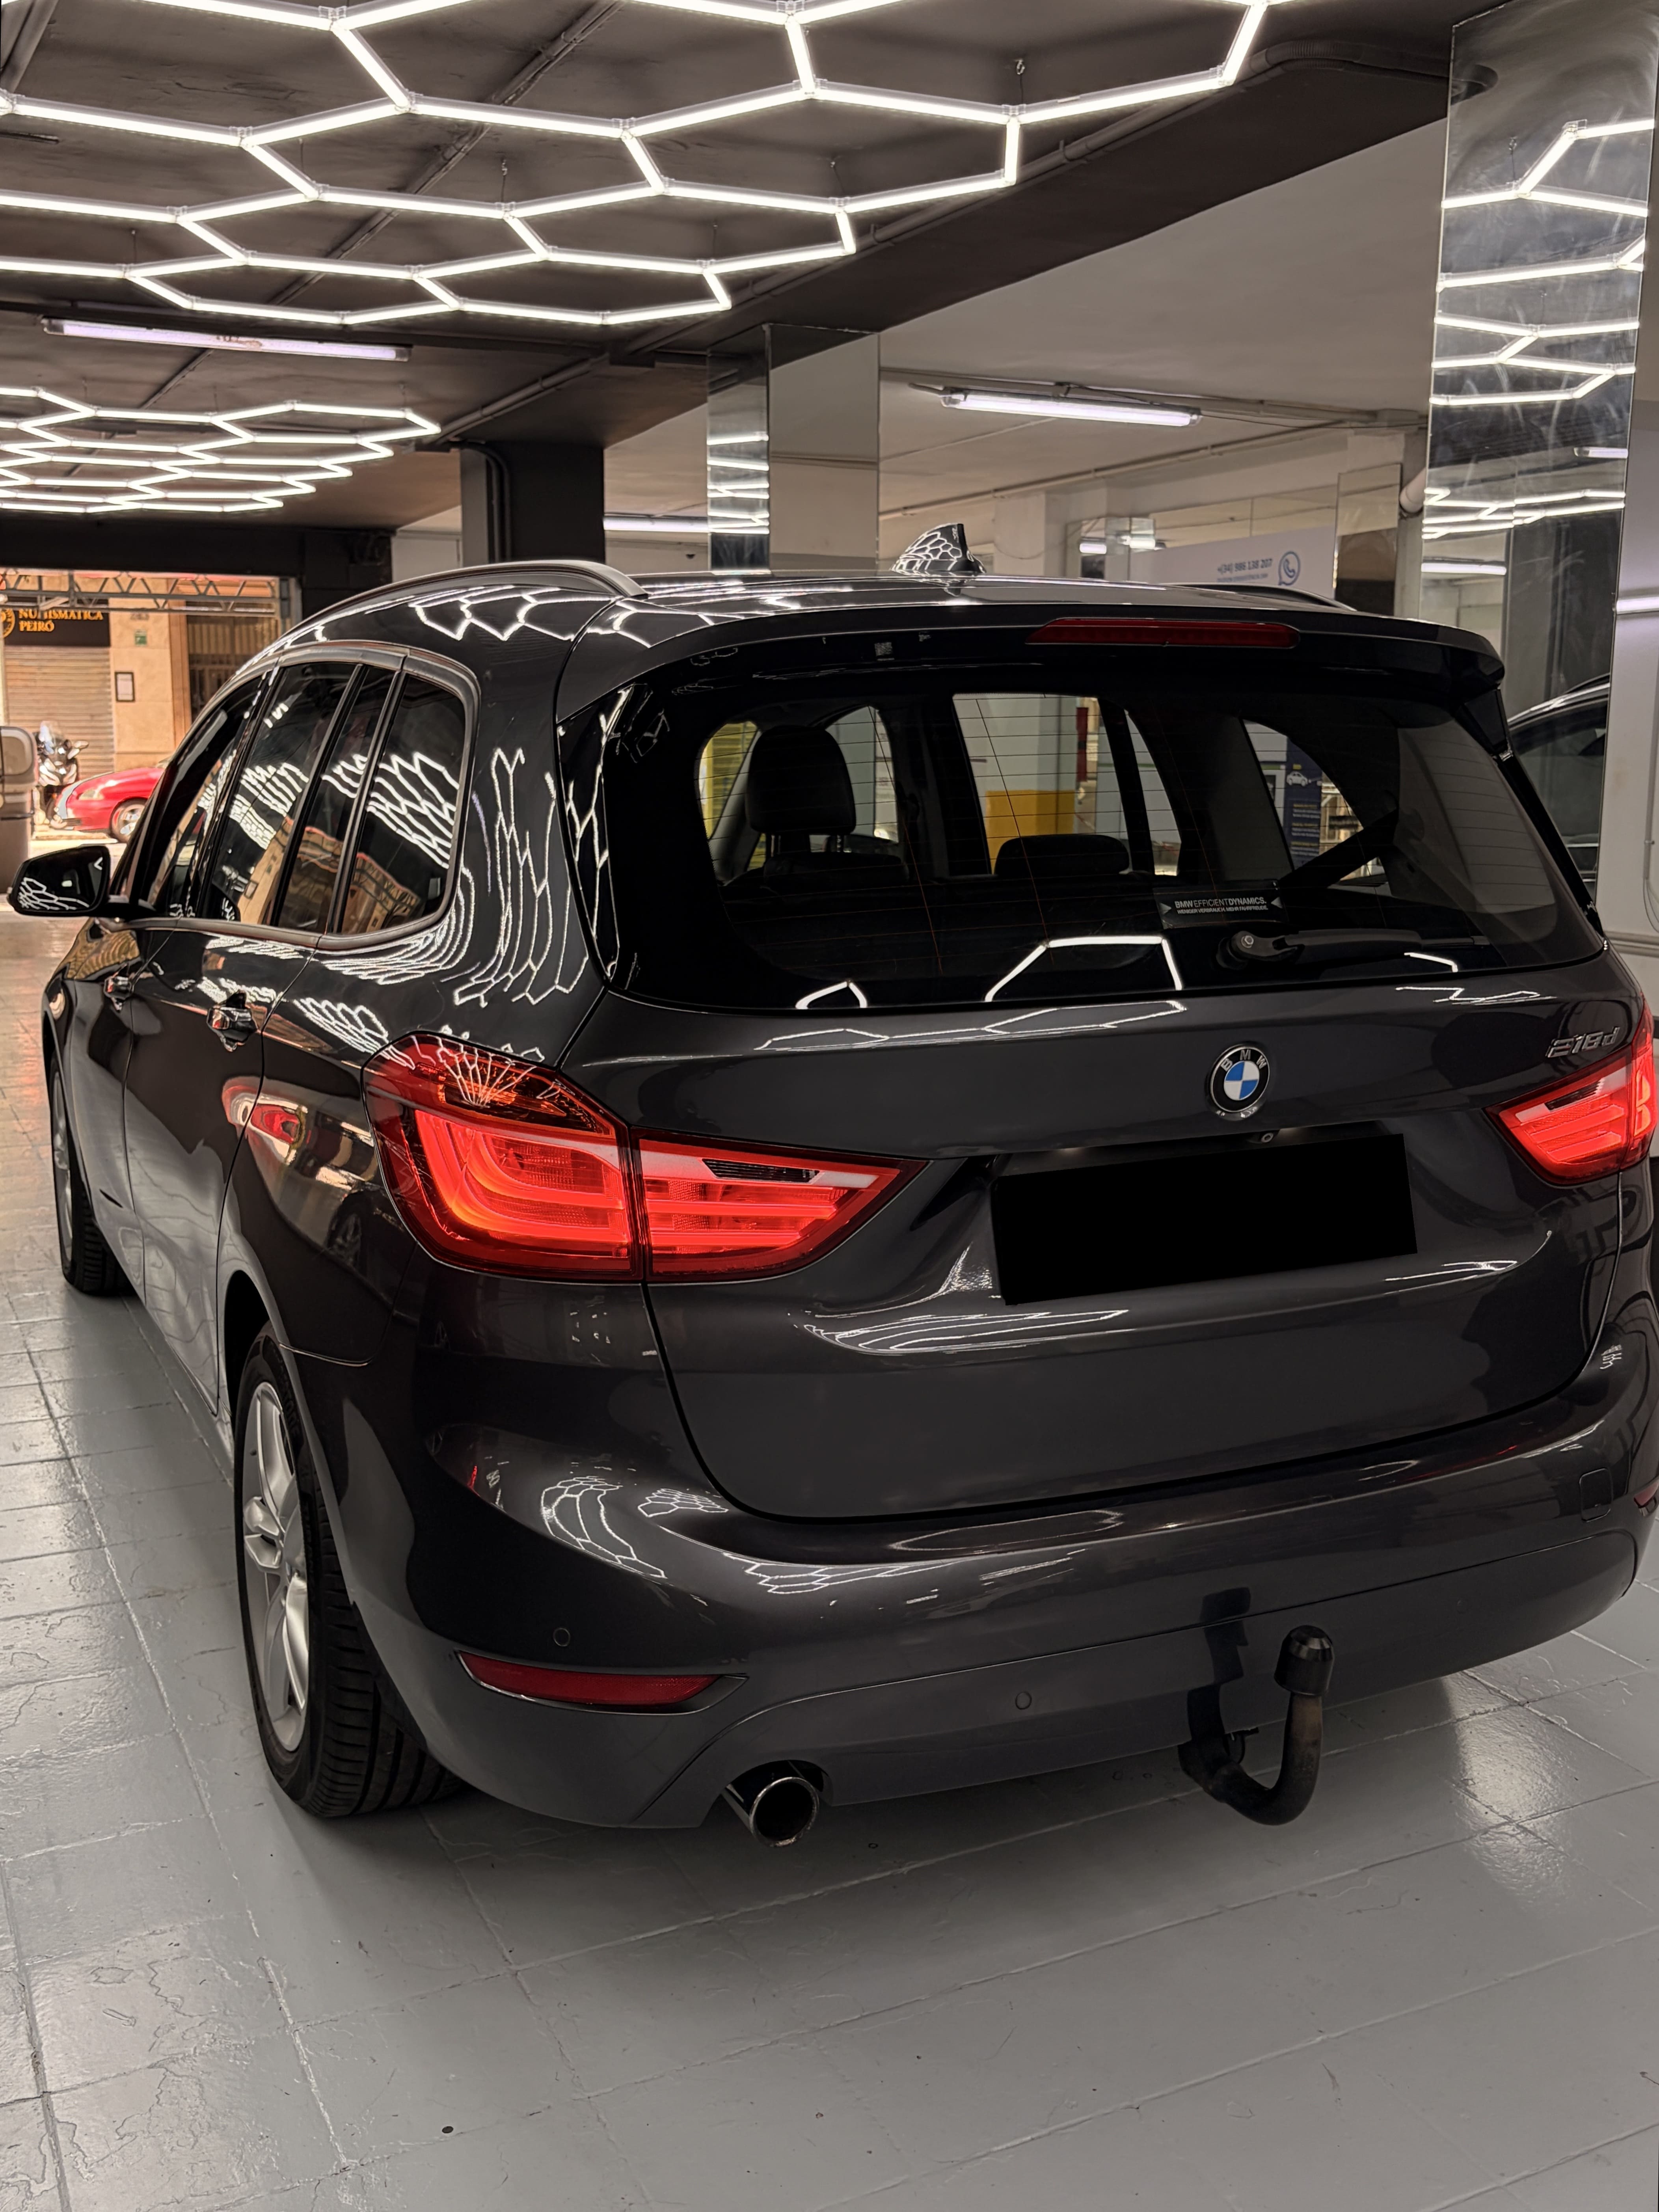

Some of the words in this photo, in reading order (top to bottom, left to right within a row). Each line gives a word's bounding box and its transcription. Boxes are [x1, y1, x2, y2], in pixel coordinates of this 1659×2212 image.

[19, 620, 55, 632] PEIRÓ
[1547, 1026, 1620, 1058] 218d
[1221, 1049, 1268, 1072] BMW
